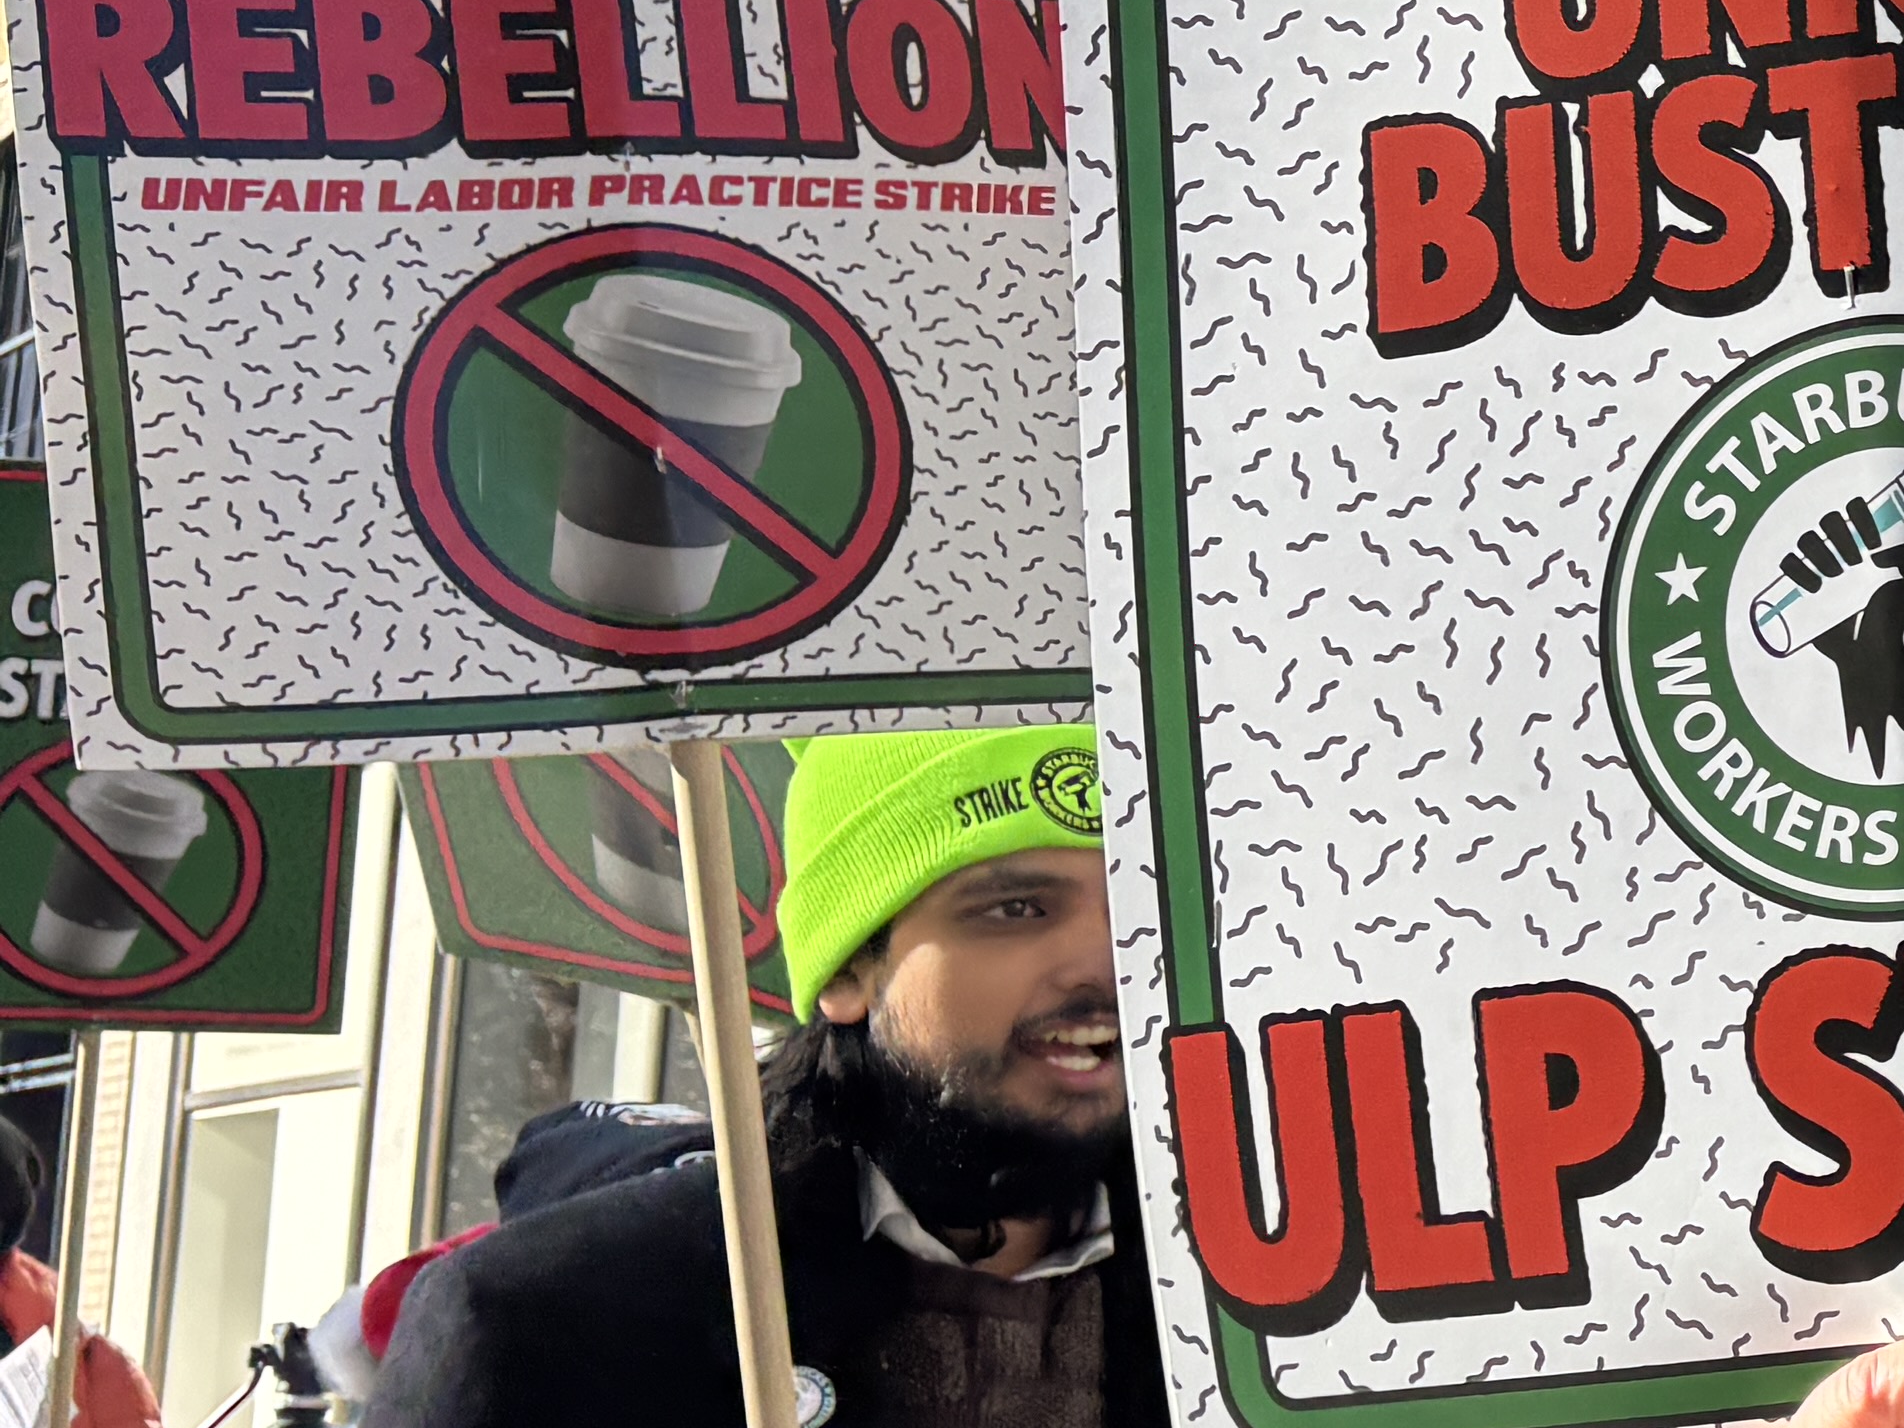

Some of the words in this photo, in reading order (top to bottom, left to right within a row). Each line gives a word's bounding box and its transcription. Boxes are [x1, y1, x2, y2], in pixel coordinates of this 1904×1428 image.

[140, 174, 365, 214] UNFAIR
[377, 175, 576, 213] LABOR
[587, 173, 863, 212] PRACTICE
[871, 179, 1057, 219] STRIKE
[953, 776, 1030, 829] STRIKE
[1652, 630, 1900, 866] WORKERS
[1160, 978, 1664, 1336] ULP
